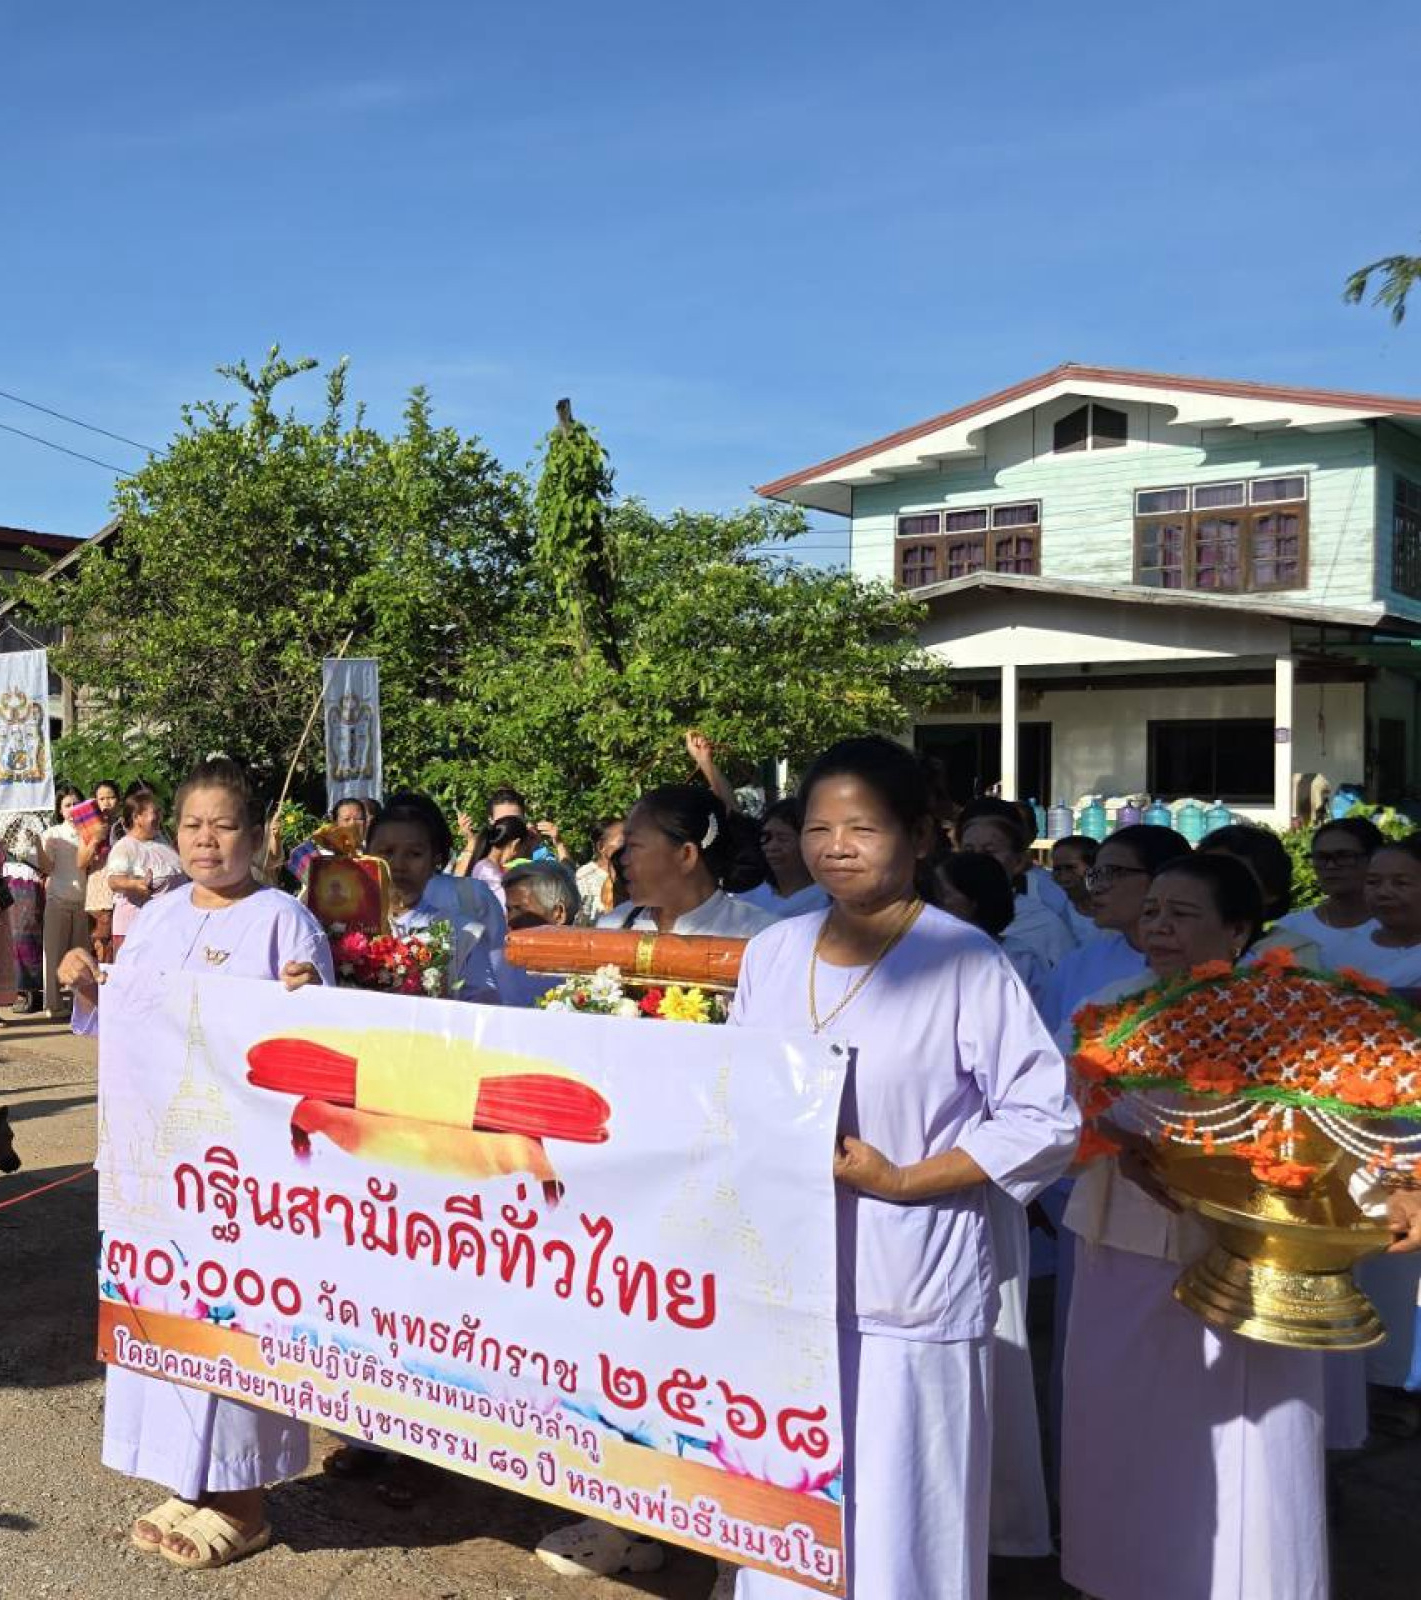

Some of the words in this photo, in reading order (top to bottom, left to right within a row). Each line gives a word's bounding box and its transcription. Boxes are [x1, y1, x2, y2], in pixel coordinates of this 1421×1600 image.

[174, 1146, 716, 1329] กฐินสามัคคีทั่วไทย
[108, 1239, 302, 1316] ๓๐,๐๐๐
[318, 1280, 359, 1328] วัด
[371, 1306, 578, 1394] พุทธศักราช
[598, 1353, 830, 1459] ๒๕๖๘
[261, 1335, 600, 1464] ศูนย์ปฏิบัติธรรมหนองบัวลำภู
[489, 1450, 528, 1480] ๘๑
[537, 1451, 556, 1487] ปี
[566, 1470, 834, 1577] หลวงพ่อธัมมชโย
